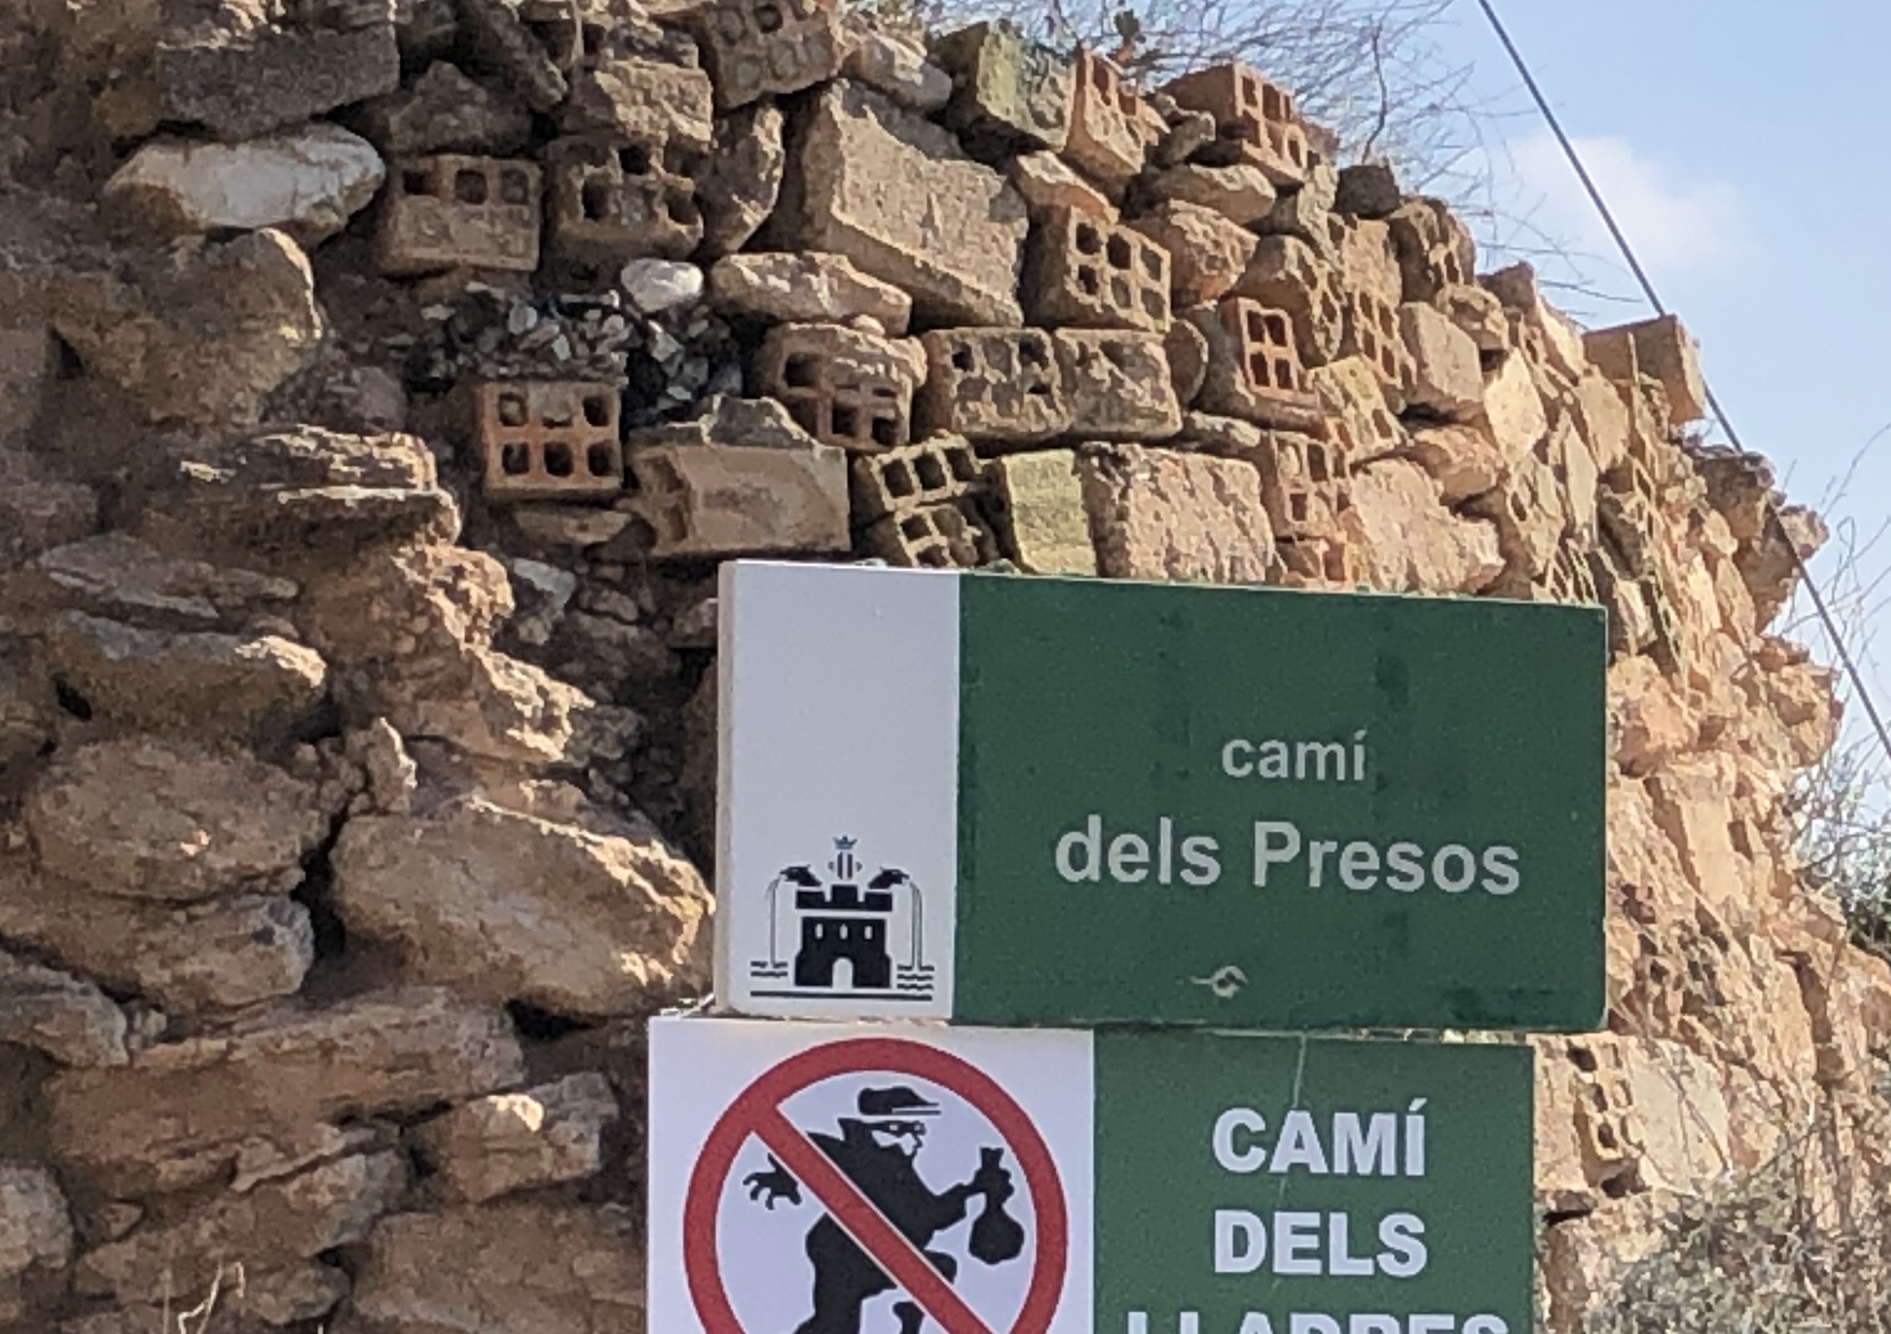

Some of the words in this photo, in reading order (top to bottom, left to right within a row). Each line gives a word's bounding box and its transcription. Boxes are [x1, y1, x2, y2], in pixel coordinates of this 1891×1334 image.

[1222, 728, 1368, 781] camí
[1055, 814, 1221, 886] dels
[1253, 821, 1521, 895] Presos
[1211, 1097, 1427, 1177] CAMÍ
[1213, 1209, 1428, 1278] DELS
